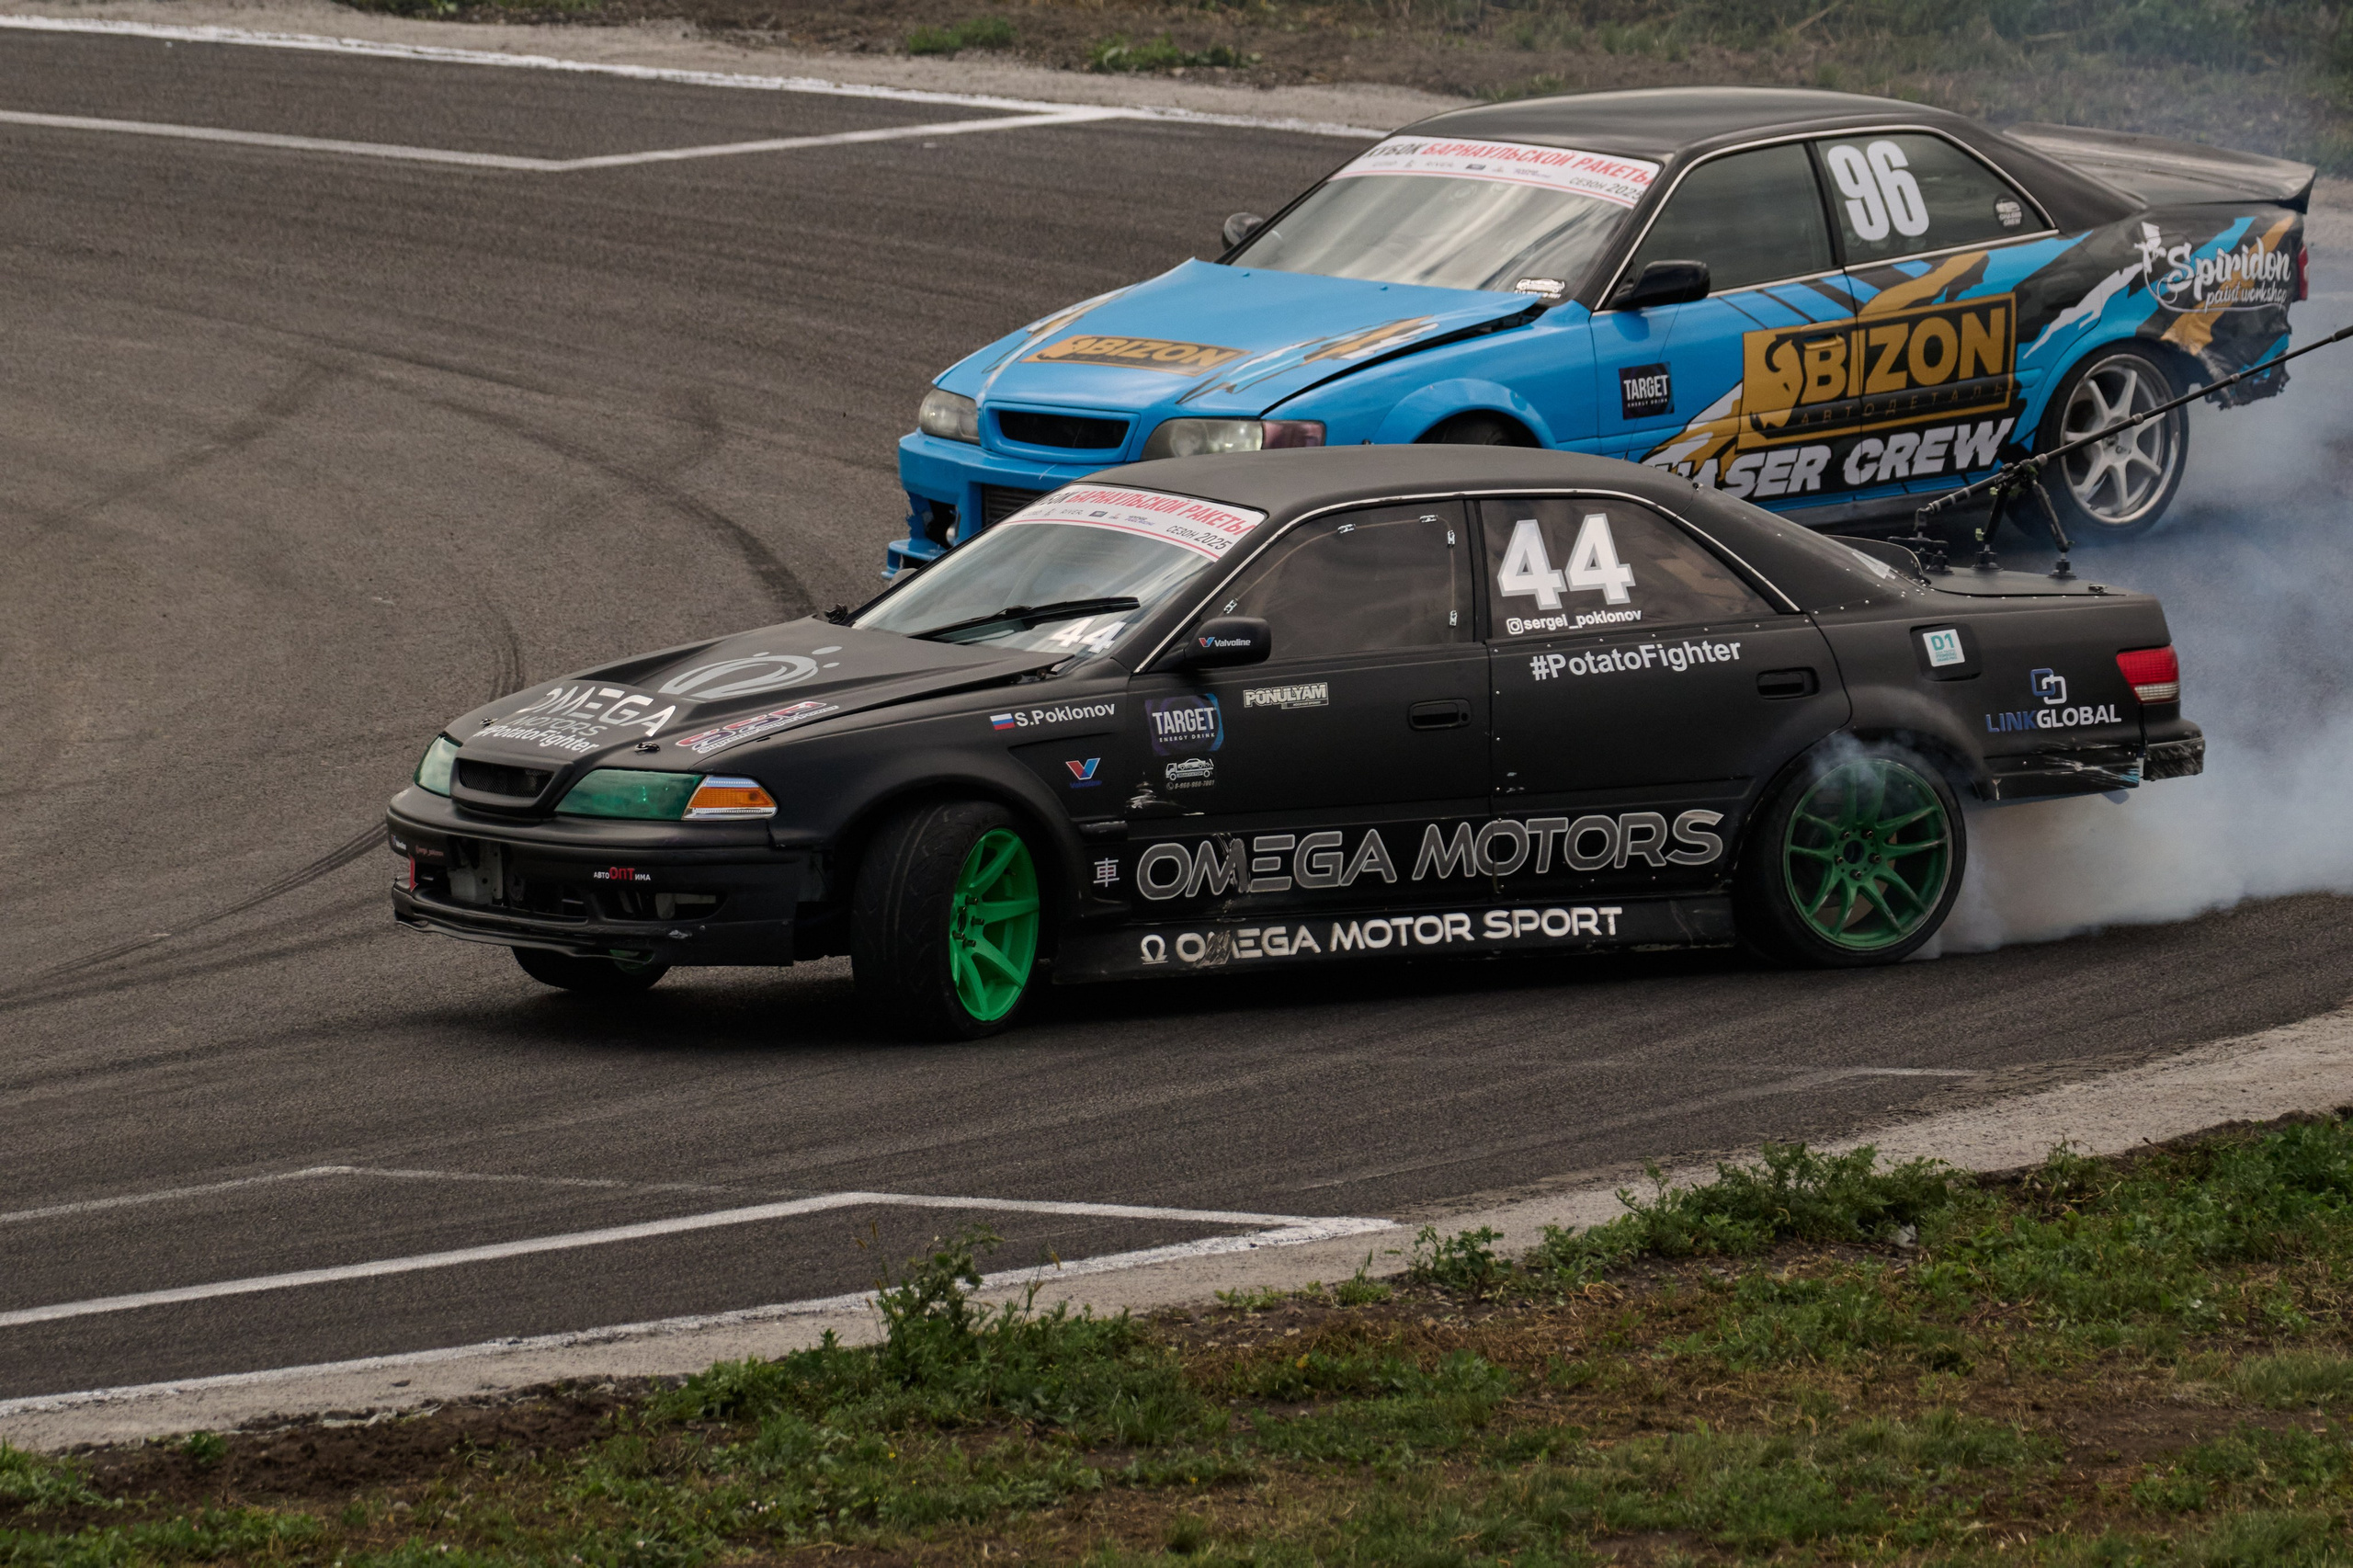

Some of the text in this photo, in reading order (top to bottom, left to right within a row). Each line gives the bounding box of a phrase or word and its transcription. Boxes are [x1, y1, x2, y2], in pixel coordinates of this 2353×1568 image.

[1421, 142, 1576, 166] БАРНАУЛЬСКОЙ
[1569, 177, 1643, 199] СЕЗОН 2025
[1827, 141, 1929, 241] 96
[2166, 236, 2290, 301] Spiridon
[2204, 280, 2287, 313] paint workshop
[1076, 337, 1237, 367] BIZON
[1801, 307, 2006, 404] BIZON
[1623, 375, 1669, 401] TARGET
[1843, 417, 2015, 485] CREW
[1064, 490, 1191, 517] БАРНАУЛЬСКОЙ
[1177, 504, 1257, 536] РАКЕТЫ
[1166, 525, 1233, 551] СЕЗОН 2025
[1497, 513, 1636, 610] 44
[1050, 618, 1127, 653] 44
[1214, 639, 1251, 647] Valvoline
[1931, 633, 1955, 651] D1
[1529, 641, 1741, 681] #PotatoFighter
[1245, 684, 1326, 706] PONULYAM
[507, 715, 608, 736] MOTORS
[516, 686, 676, 737] OMEGA
[1015, 703, 1116, 727] S.Poklonov
[1152, 707, 1215, 735] TARGET
[473, 724, 599, 753] #PotatoFighter
[1137, 810, 1724, 900] OMEGA MOTORS
[1330, 913, 1474, 951] MOTOR
[1483, 906, 1622, 938] SPORT
